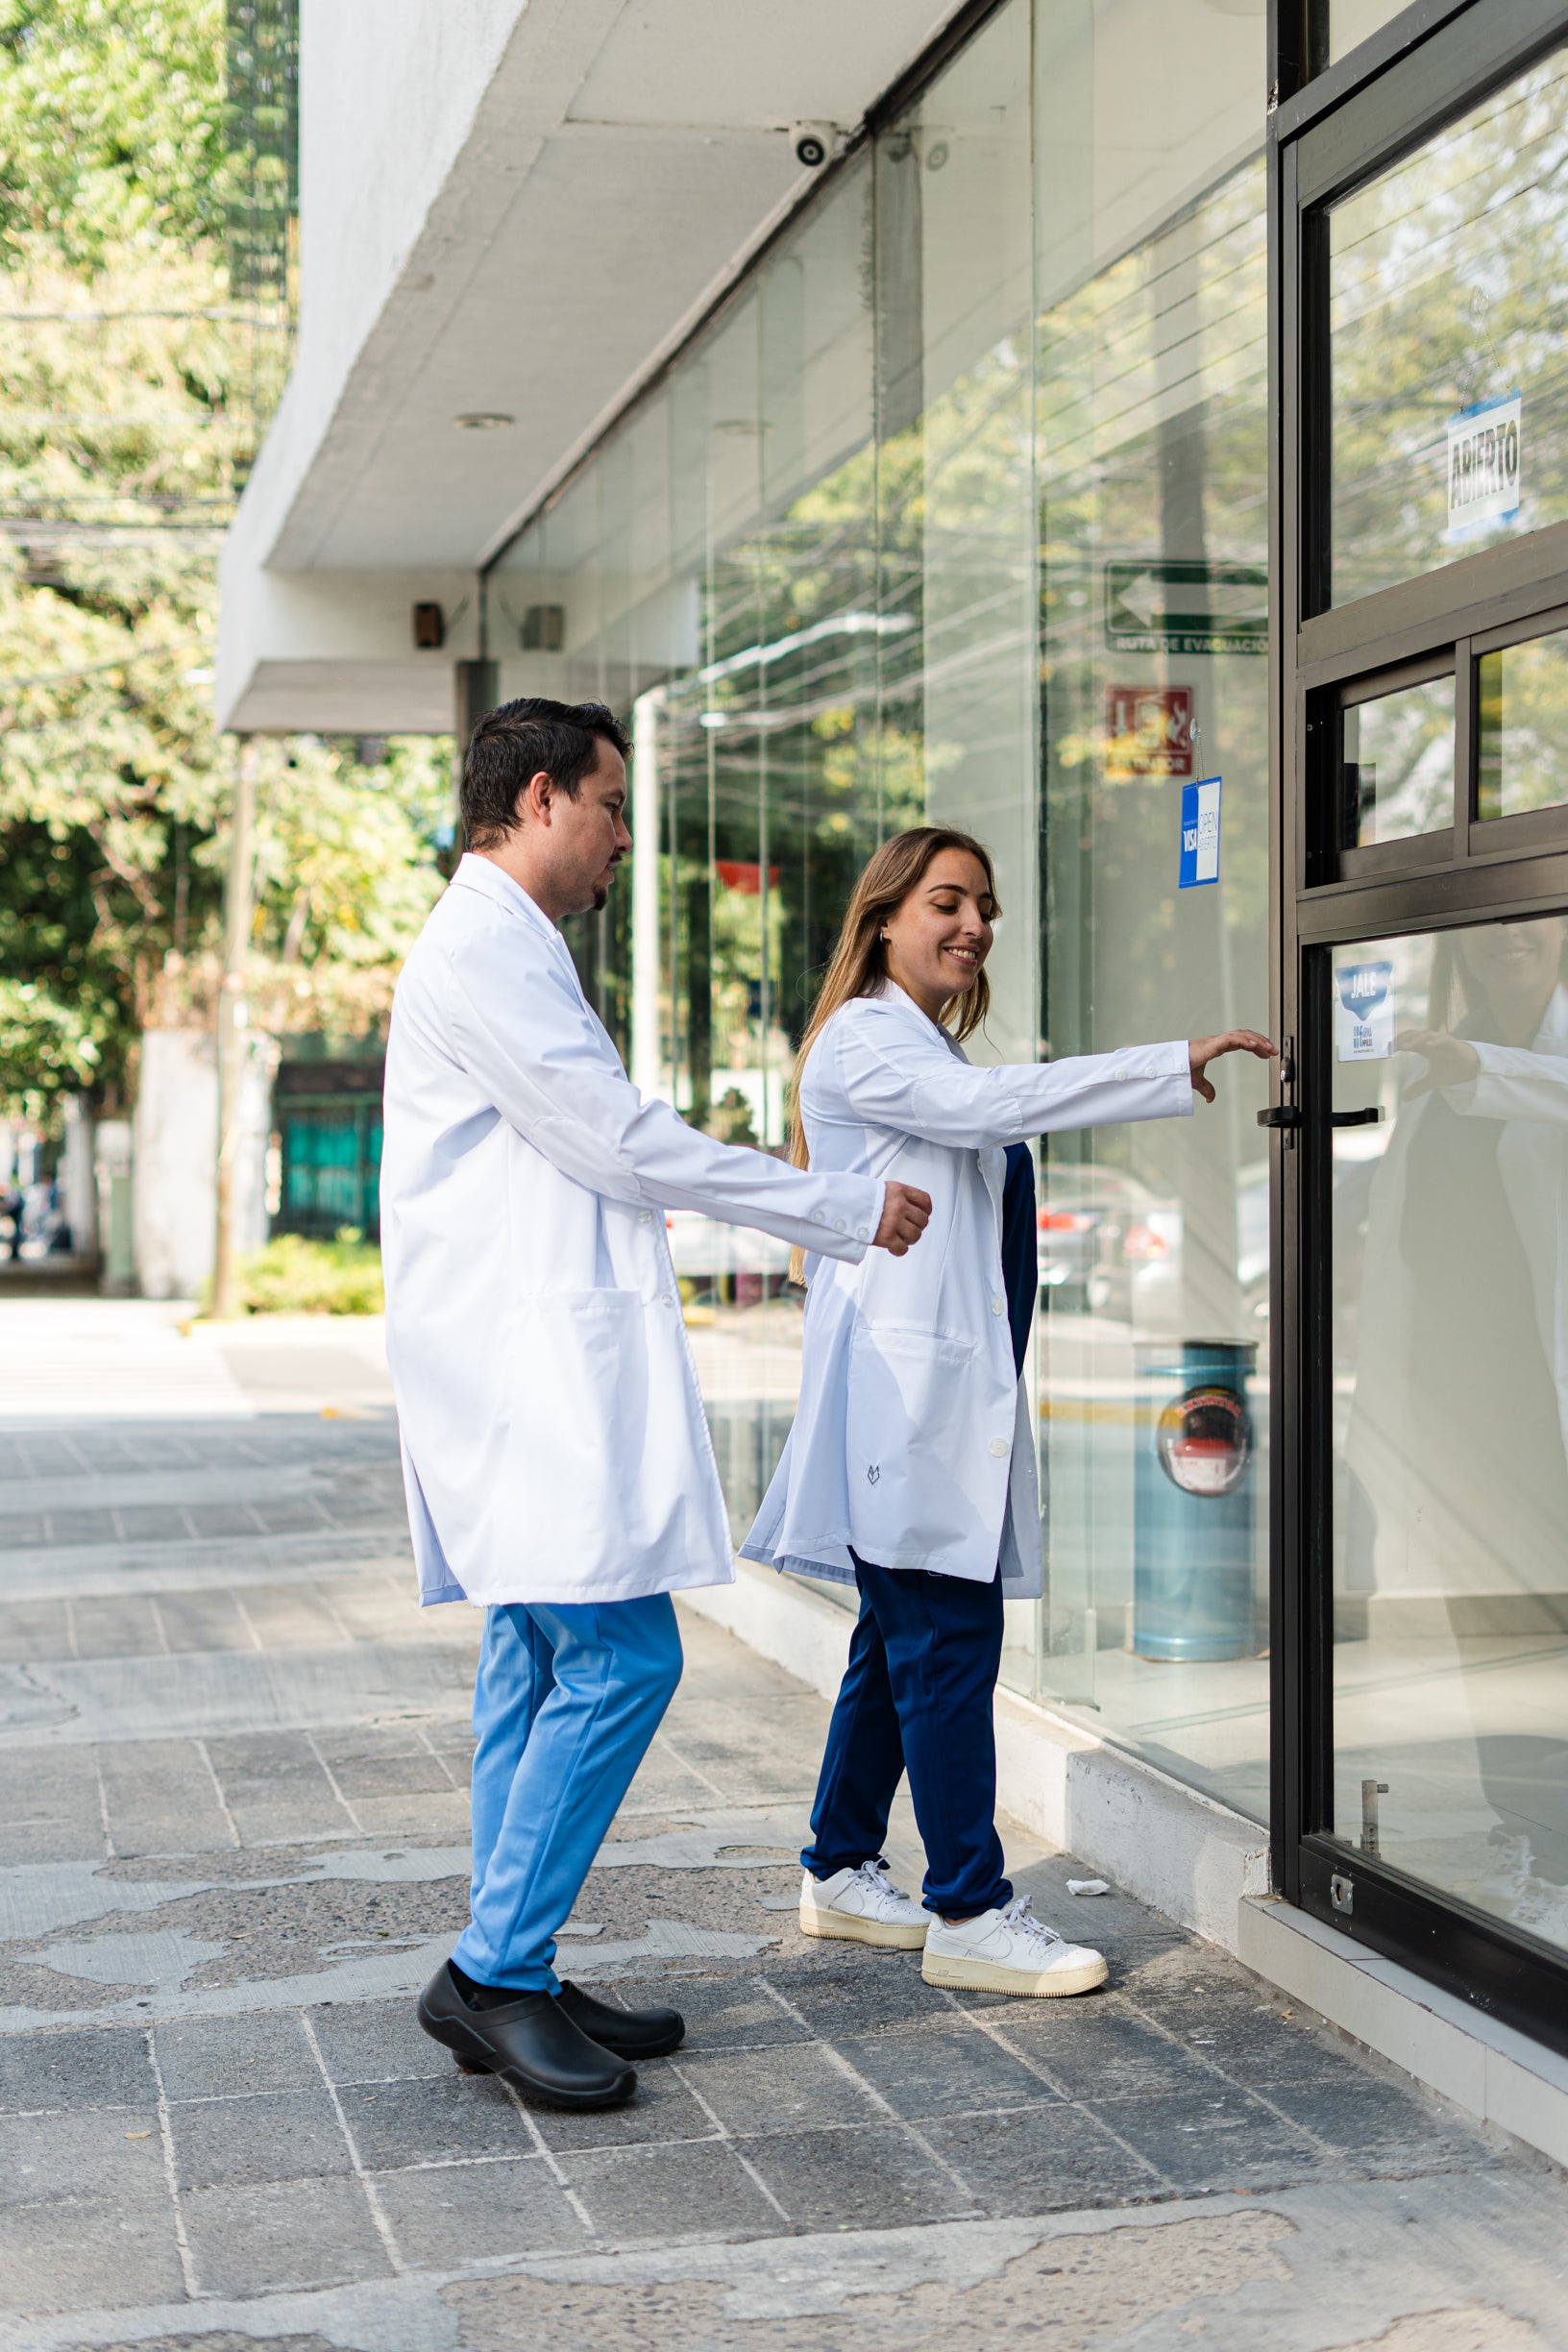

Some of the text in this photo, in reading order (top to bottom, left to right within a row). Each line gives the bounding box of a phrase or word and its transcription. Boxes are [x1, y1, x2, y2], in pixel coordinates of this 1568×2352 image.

[1451, 420, 1518, 510] ABIERTO
[1116, 636, 1157, 650] RUTA
[1160, 637, 1181, 651] DE
[1199, 810, 1217, 835] OPEN
[1183, 827, 1198, 853] VISA
[1351, 972, 1376, 999] JALE
